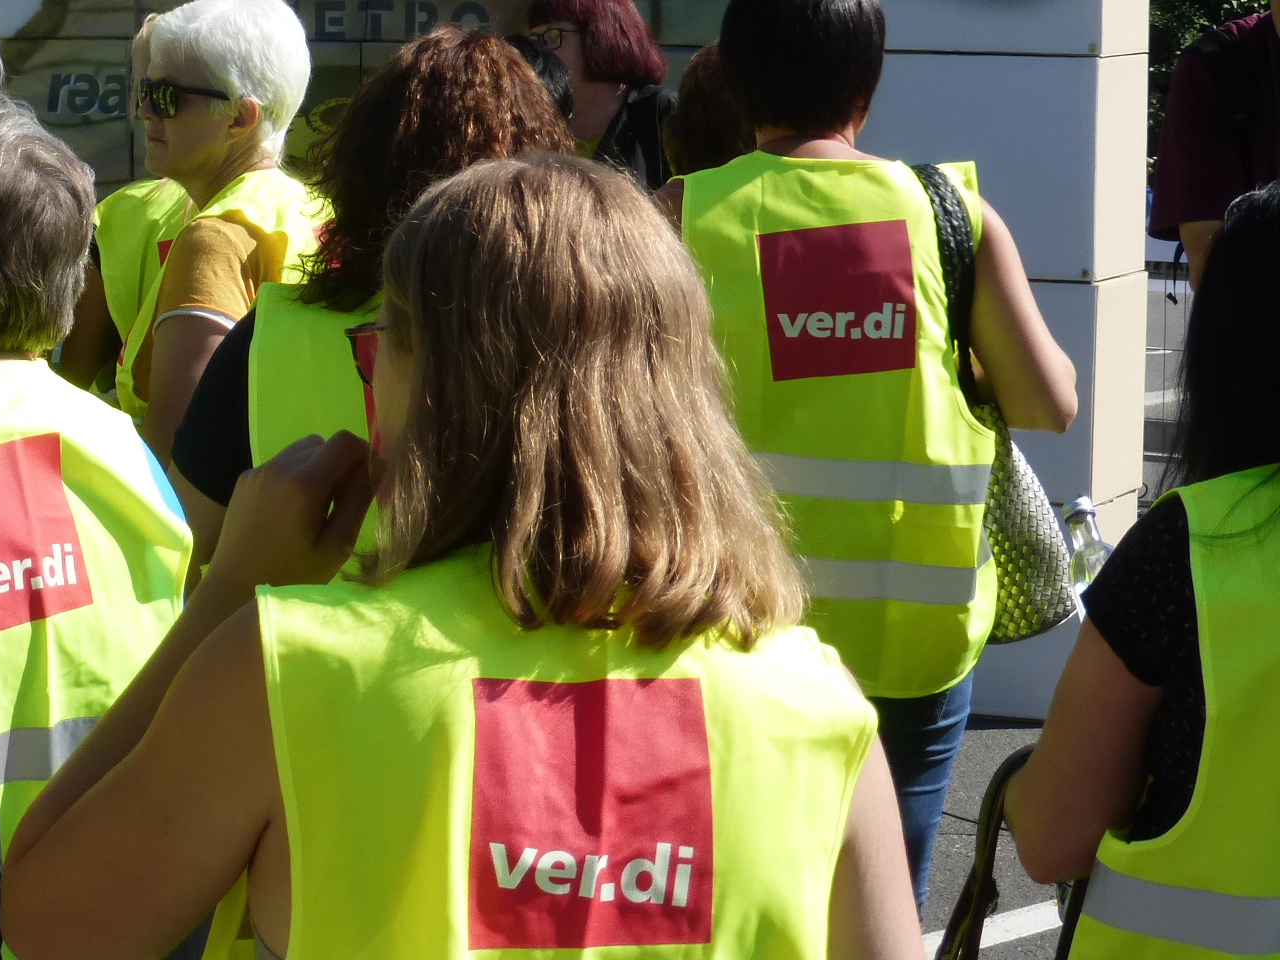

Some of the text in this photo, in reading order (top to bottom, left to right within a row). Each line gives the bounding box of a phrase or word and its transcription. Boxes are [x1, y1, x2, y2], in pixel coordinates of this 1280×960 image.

[314, 0, 490, 40] ETRO
[777, 302, 906, 341] ver.di
[489, 841, 695, 909] ver.di
